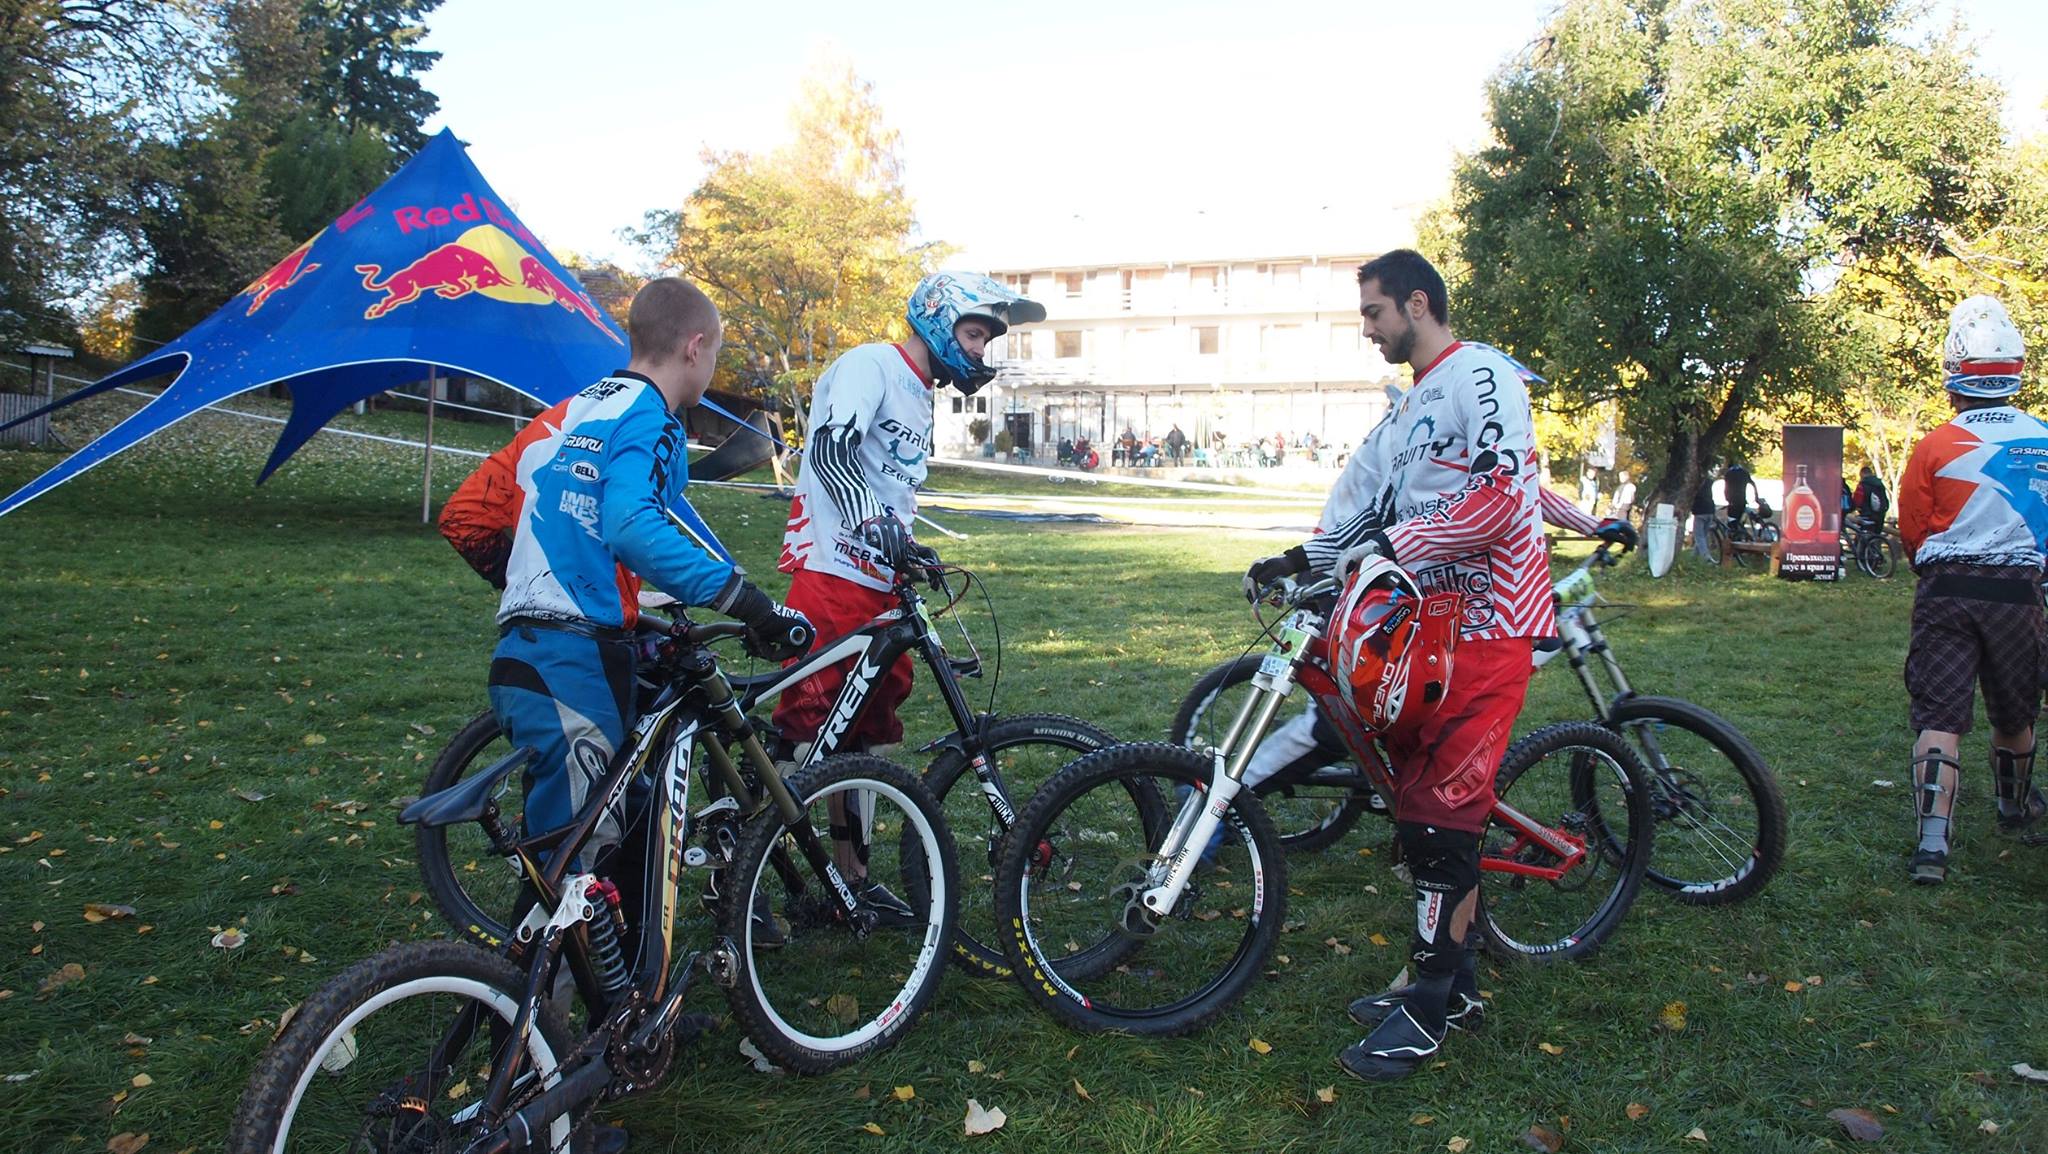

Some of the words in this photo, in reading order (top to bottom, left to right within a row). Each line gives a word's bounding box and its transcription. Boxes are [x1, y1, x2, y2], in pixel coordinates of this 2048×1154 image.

[393, 193, 481, 235] Red
[2022, 447, 2048, 456] SUNTO
[575, 465, 596, 479] BELL
[1373, 662, 1396, 723] ONEAL
[809, 655, 881, 763] TREK
[1033, 727, 1076, 739] MINION
[667, 742, 691, 886] DRAG
[1538, 826, 1571, 852] SYNERGY
[468, 923, 501, 947] XIS
[955, 942, 1014, 978] MAXX
[1013, 917, 1057, 996] MAXXIS
[790, 1040, 835, 1060] MAGIC
[839, 1037, 880, 1060] MARY
